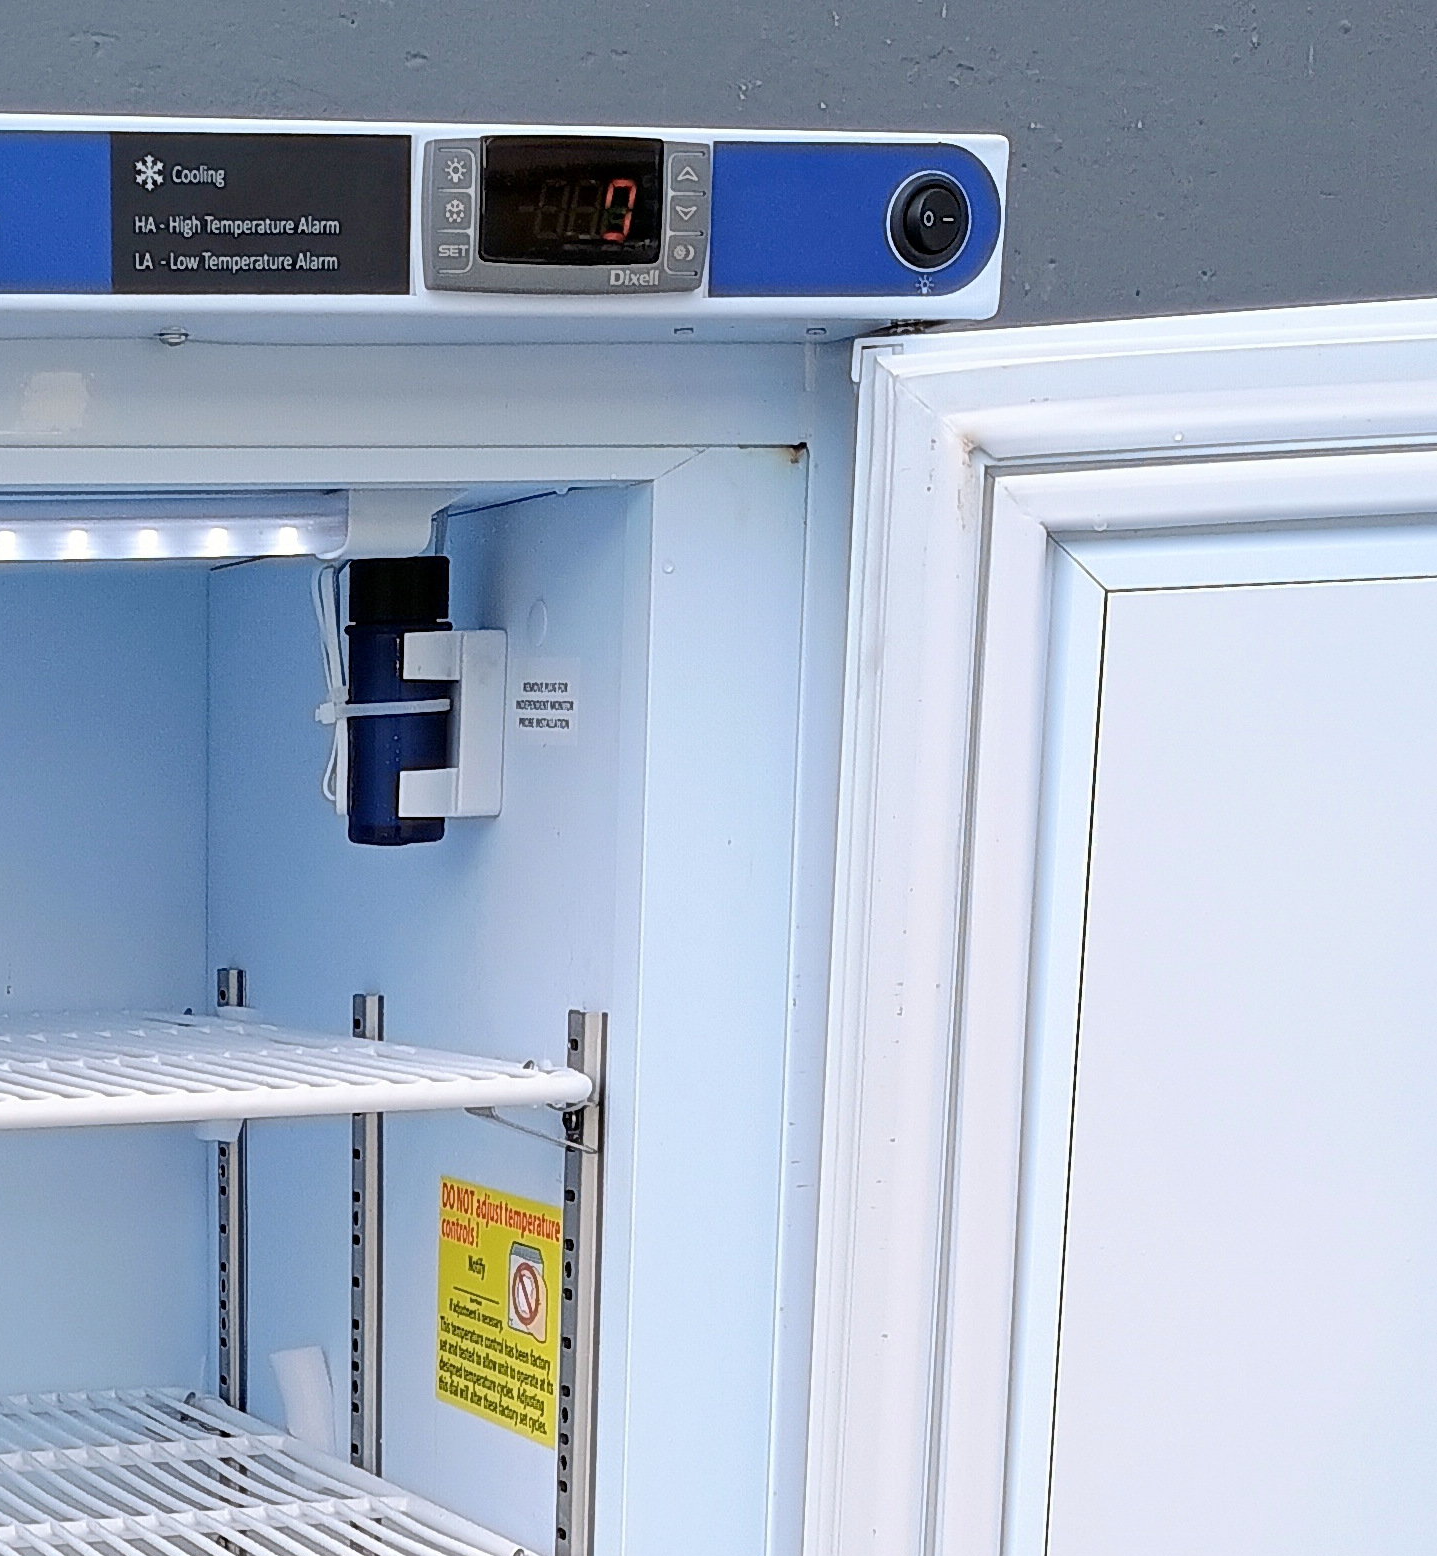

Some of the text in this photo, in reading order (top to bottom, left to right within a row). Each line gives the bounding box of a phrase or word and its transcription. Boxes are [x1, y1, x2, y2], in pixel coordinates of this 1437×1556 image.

[172, 165, 225, 187] Cooling
[134, 216, 157, 233] HA
[169, 216, 201, 237] High
[204, 216, 295, 237] Temperature
[297, 216, 340, 234] Alarm
[438, 245, 469, 257] SET
[134, 252, 154, 270] LA
[169, 252, 200, 270] Low
[201, 252, 293, 274] Temperature
[295, 252, 338, 270] Alarm
[609, 269, 660, 286] Dixell
[442, 1181, 560, 1242] DO NOT adjust temperature
[440, 1315, 551, 1383] This temperature control has been factory
[448, 1340, 459, 1358] and
[458, 1344, 476, 1365] tested
[482, 1352, 498, 1373] allow
[438, 1374, 449, 1393] this
[463, 1365, 497, 1393] temperature
